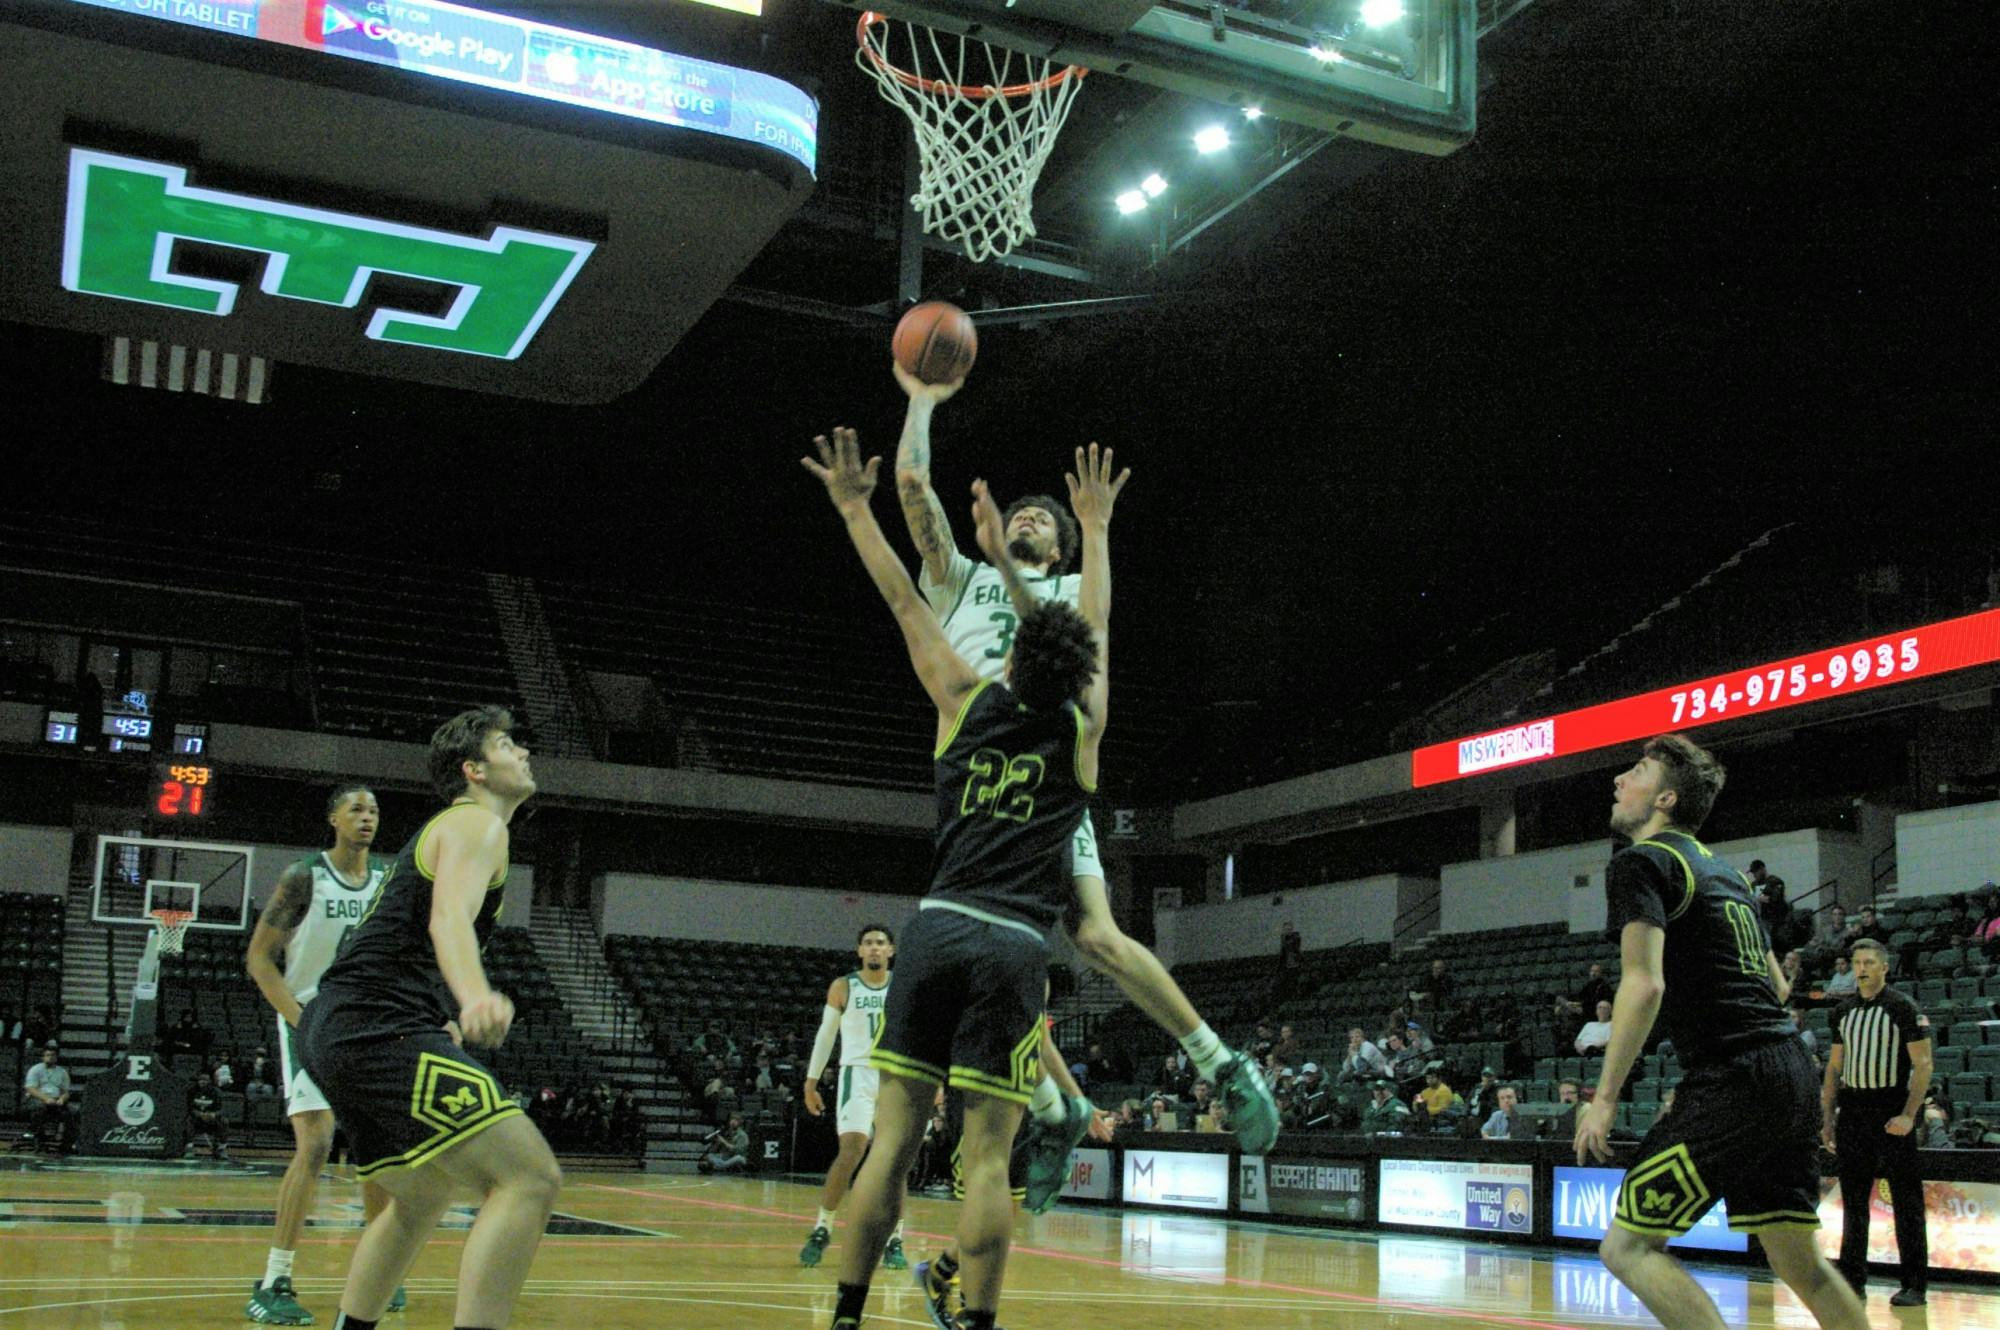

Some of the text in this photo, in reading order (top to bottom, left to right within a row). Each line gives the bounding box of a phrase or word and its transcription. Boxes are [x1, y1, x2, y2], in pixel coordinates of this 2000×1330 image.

[170, 0, 254, 31] TABLET
[366, 1, 392, 15] GET
[362, 16, 513, 72] Google Play
[591, 70, 716, 116] App Store
[754, 121, 789, 147] FOR
[1669, 637, 1921, 724] 734-975-9935
[52, 724, 78, 741] 31
[115, 719, 151, 737] 4:53
[184, 737, 203, 754] 17
[170, 765, 210, 785] 4:53
[960, 747, 1046, 823] 22
[158, 780, 204, 815] 21
[1113, 809, 1135, 834] E
[1075, 836, 1094, 858] E
[1725, 901, 1769, 977] 11
[126, 1055, 152, 1080] E
[440, 1086, 479, 1114] M
[764, 1141, 780, 1159] E
[1132, 1156, 1154, 1199] M
[1242, 1165, 1258, 1200] E
[1467, 1186, 1502, 1204] United
[1642, 1189, 1676, 1211] M
[1479, 1205, 1501, 1227] Way
